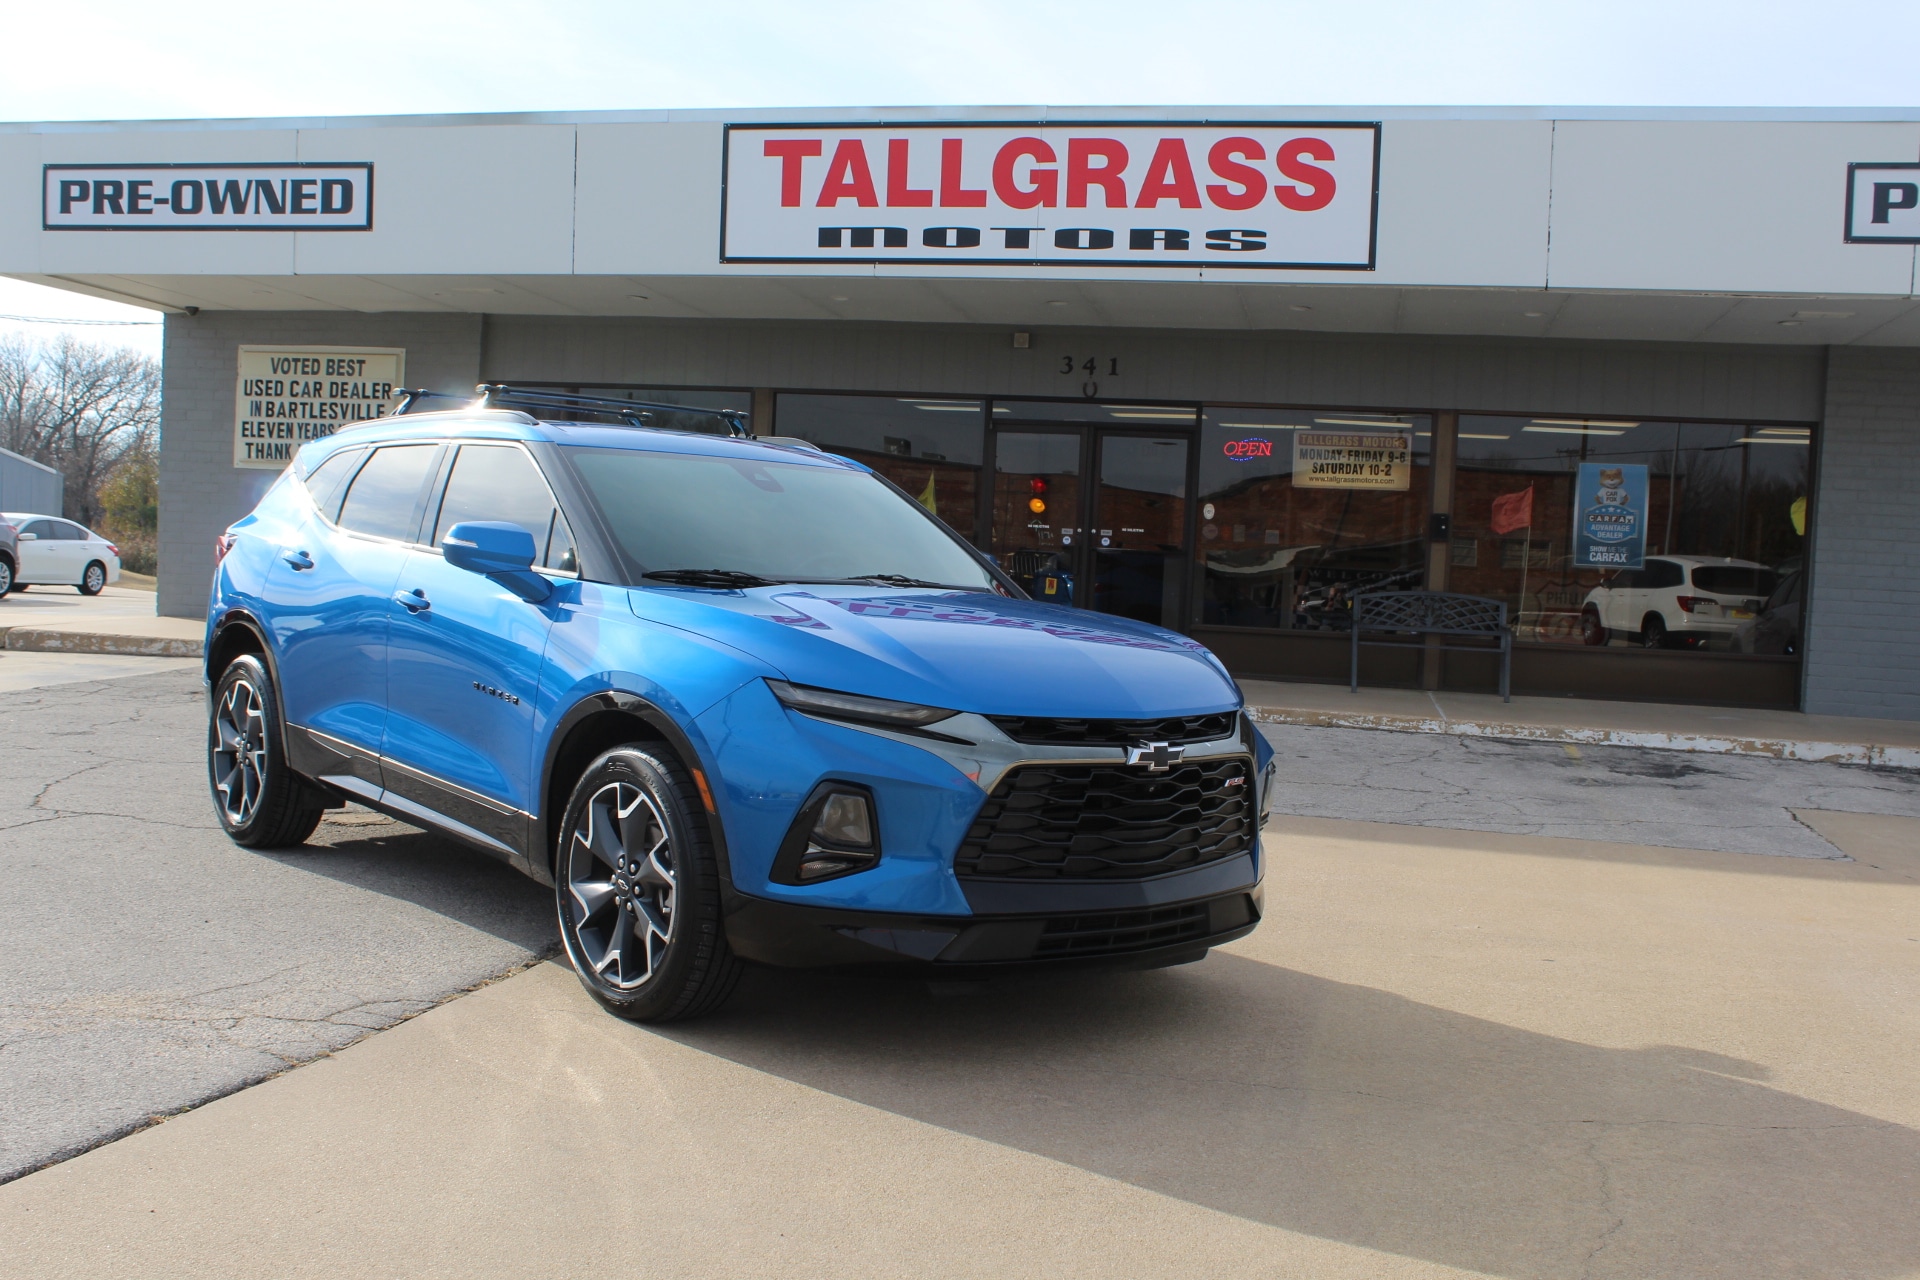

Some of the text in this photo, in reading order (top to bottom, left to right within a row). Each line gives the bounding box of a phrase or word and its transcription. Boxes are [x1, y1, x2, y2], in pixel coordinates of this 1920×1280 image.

[764, 137, 1336, 211] TALLGRASS
[60, 179, 353, 214] PRE-OWNED
[818, 227, 1267, 251] MOTORS
[271, 357, 366, 376] VOTED BEST
[1059, 356, 1119, 376] 341
[244, 379, 391, 400] USED CAR DEALER
[250, 400, 385, 420] IN BARTLESVILLE
[242, 421, 335, 440] ELEVEN YEARS
[1223, 441, 1273, 456] OPEN
[1301, 434, 1406, 449] TALLGRASS MOTORS
[245, 442, 291, 460] THANK
[1388, 451, 1406, 464] 9-6
[1312, 462, 1392, 476] SATURDAY 10-2
[1308, 475, 1395, 485] www.tallgrassmotors.com
[1588, 515, 1634, 524] CARFAX
[1590, 524, 1631, 532] ADVANTAGE
[1597, 531, 1623, 539] DEALER
[1589, 545, 1608, 553] SHOW
[1589, 552, 1628, 563] CARFAX
